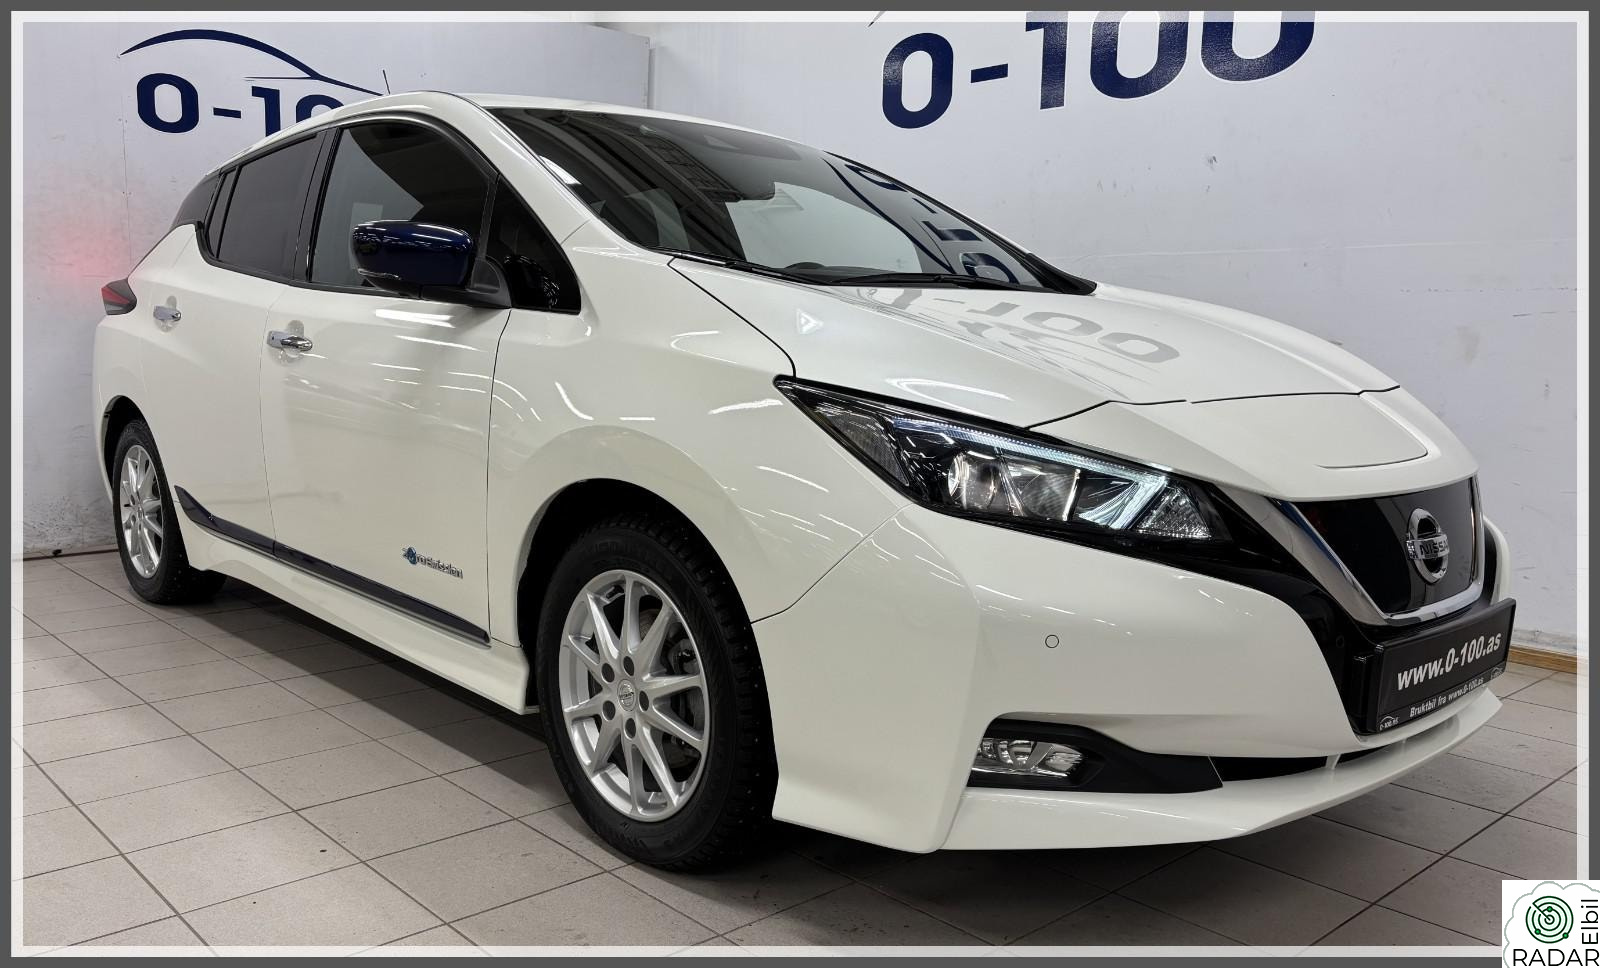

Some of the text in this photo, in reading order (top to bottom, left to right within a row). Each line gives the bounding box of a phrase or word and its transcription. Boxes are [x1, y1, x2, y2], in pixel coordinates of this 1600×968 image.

[882, 11, 1315, 129] 0-100
[1420, 540, 1448, 556] NISSA
[1397, 633, 1501, 691] www.0-100.as
[1409, 700, 1437, 718] Bruktbil
[1437, 695, 1447, 706] fra
